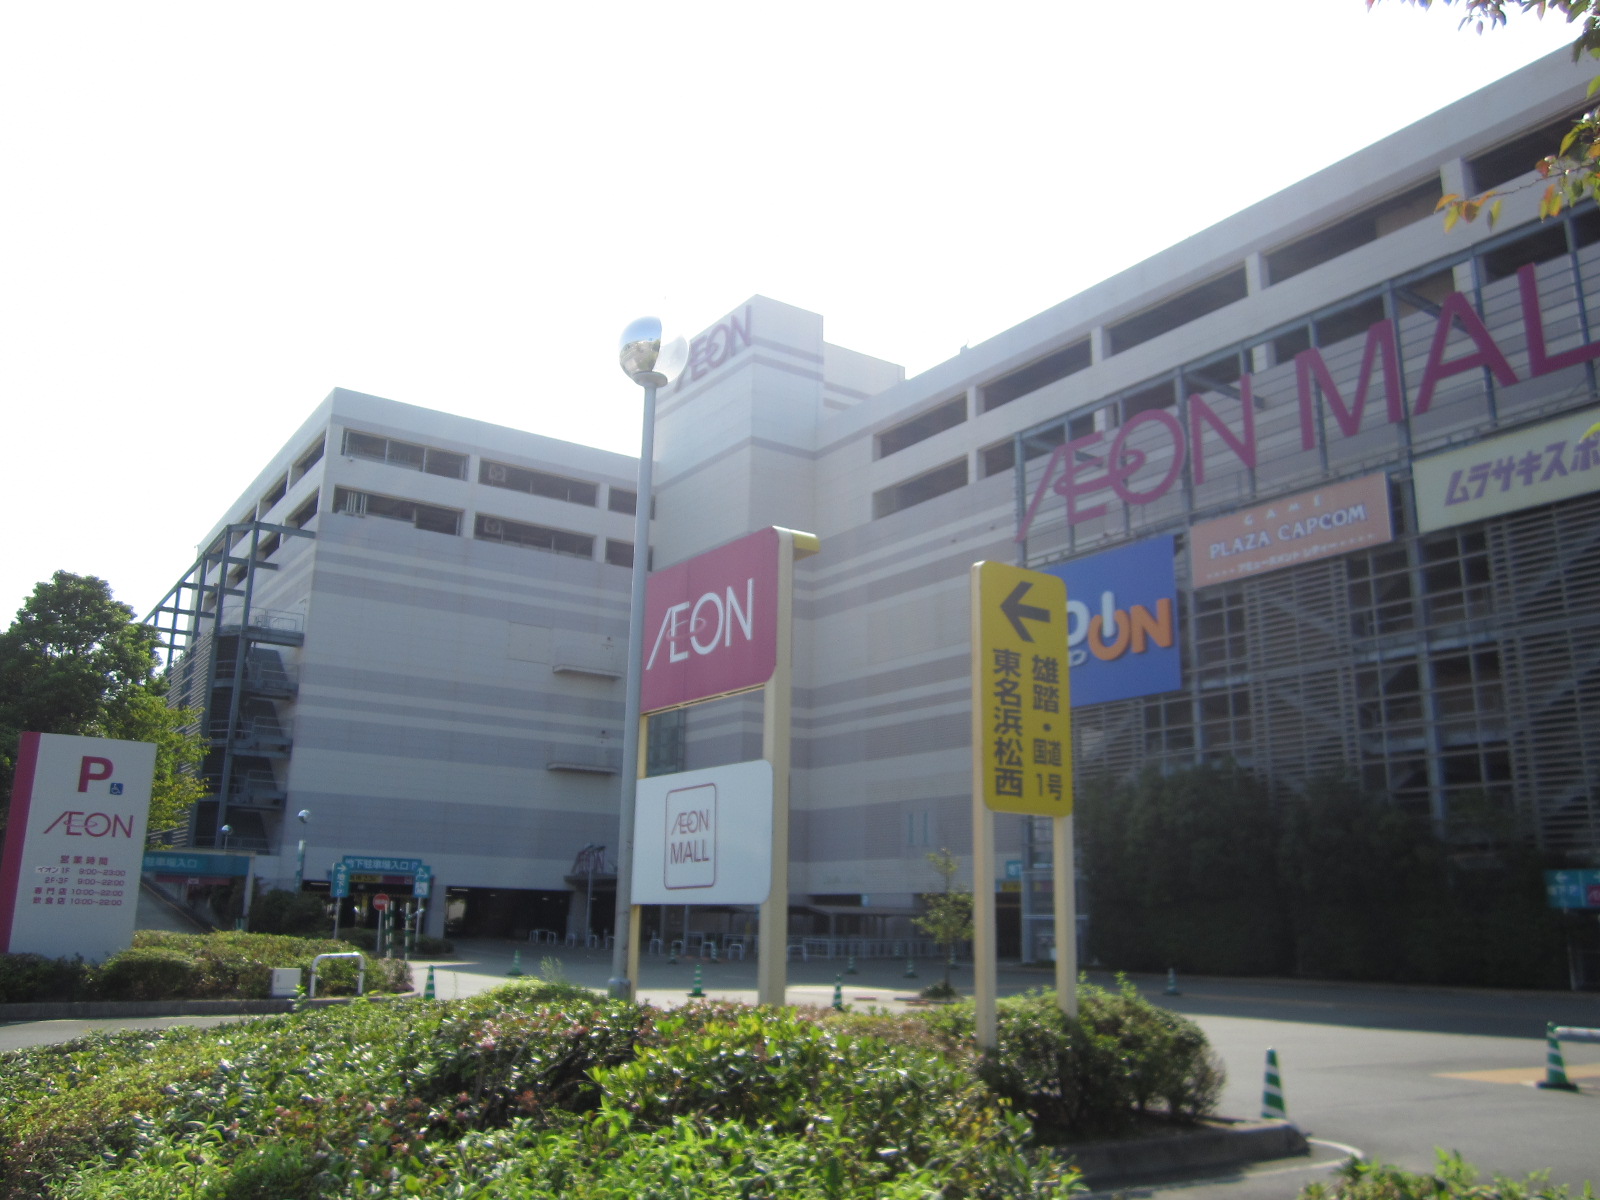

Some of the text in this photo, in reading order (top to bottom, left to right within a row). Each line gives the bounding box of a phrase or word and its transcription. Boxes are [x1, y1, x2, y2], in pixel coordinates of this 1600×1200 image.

[1209, 504, 1369, 560] PLAZA CAPCOM
[993, 648, 1025, 799] 東名浜松西
[77, 755, 114, 792] P
[670, 839, 710, 865] MALL
